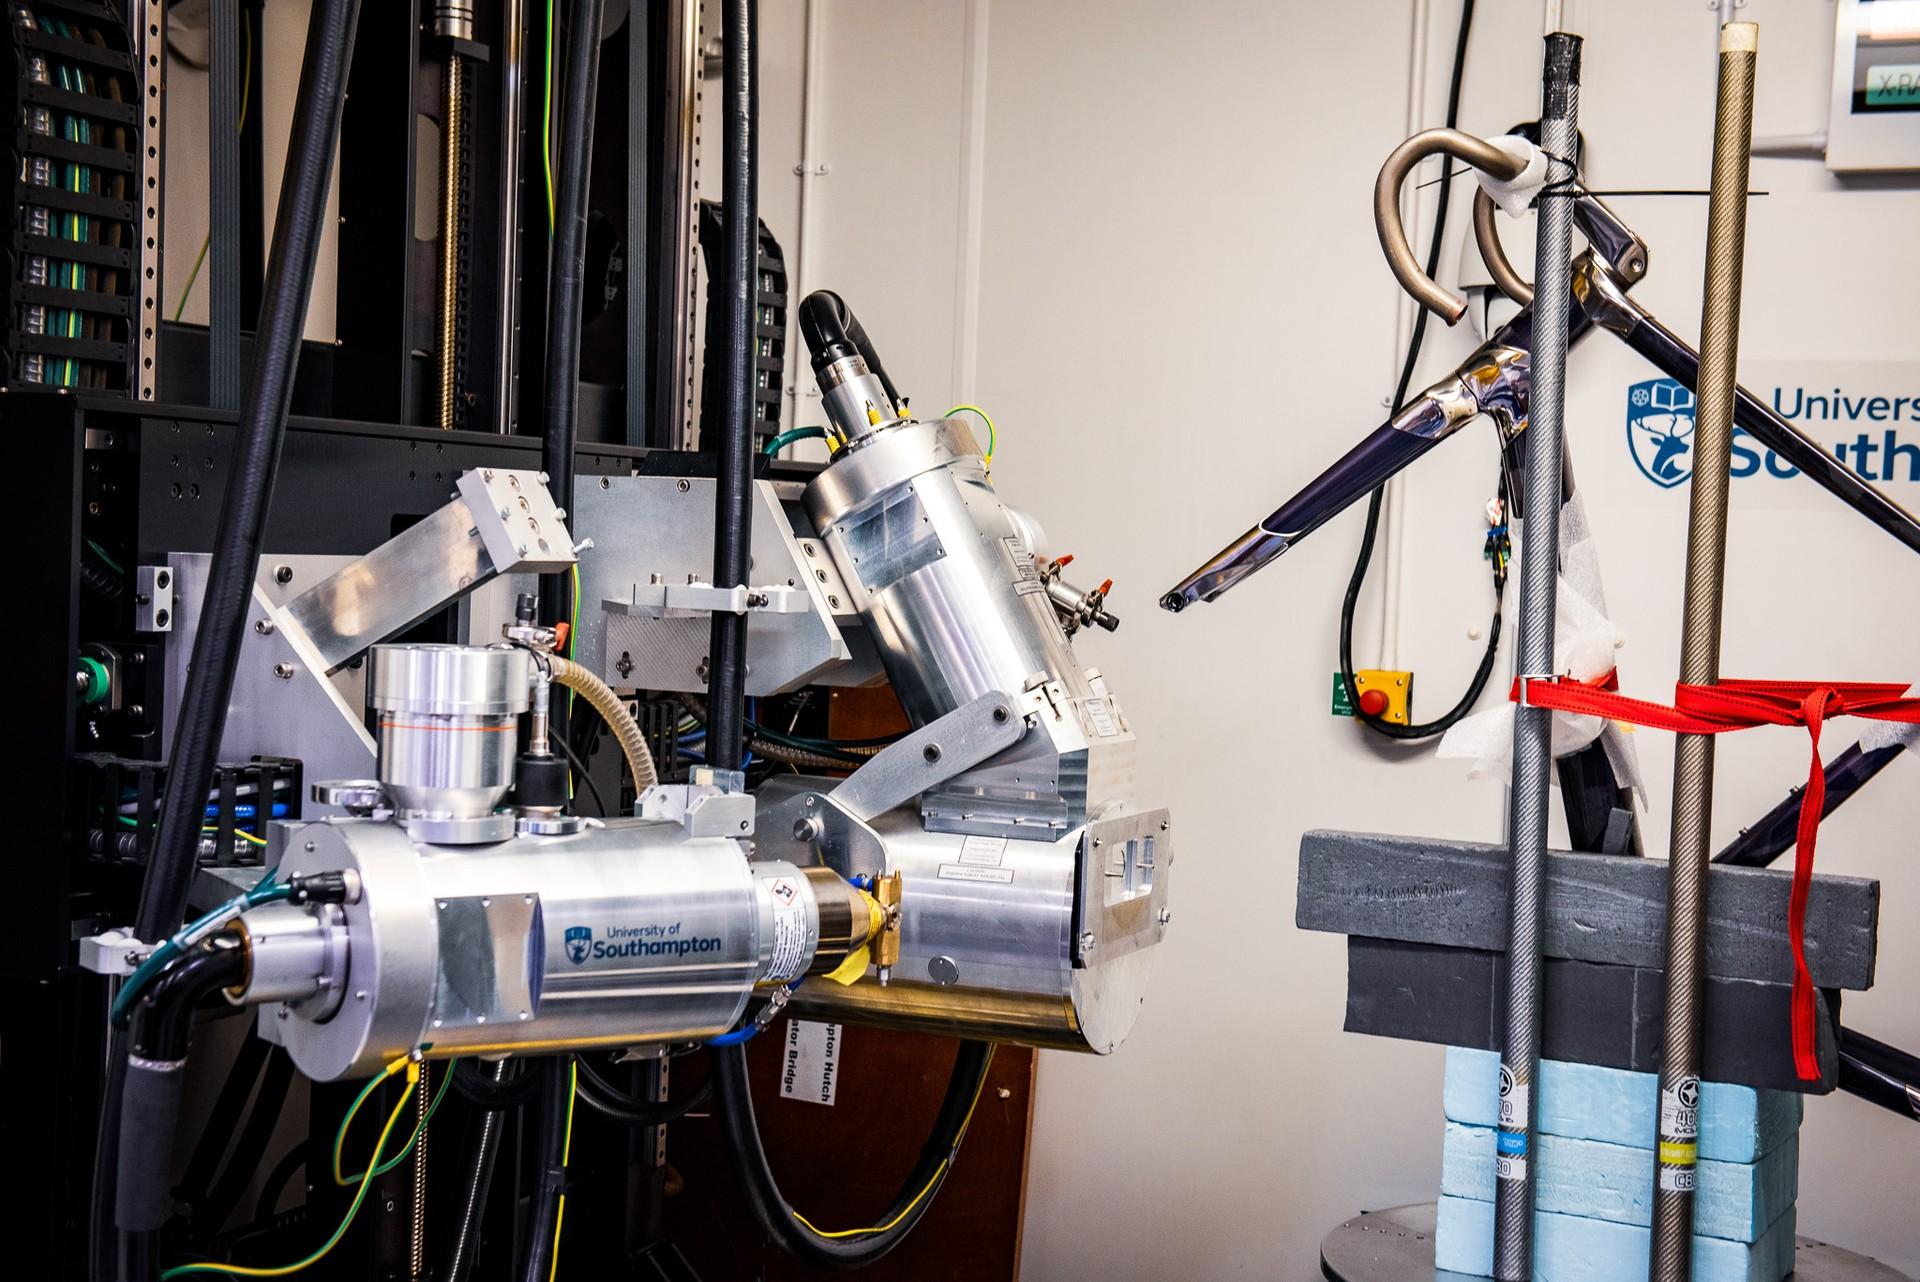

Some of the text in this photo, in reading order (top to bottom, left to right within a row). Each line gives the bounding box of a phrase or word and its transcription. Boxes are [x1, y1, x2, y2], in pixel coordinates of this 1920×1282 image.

[607, 922, 681, 939] University of
[593, 936, 721, 959] Southampton
[784, 1050, 798, 1093] Bridge
[821, 1062, 834, 1102] Hutch
